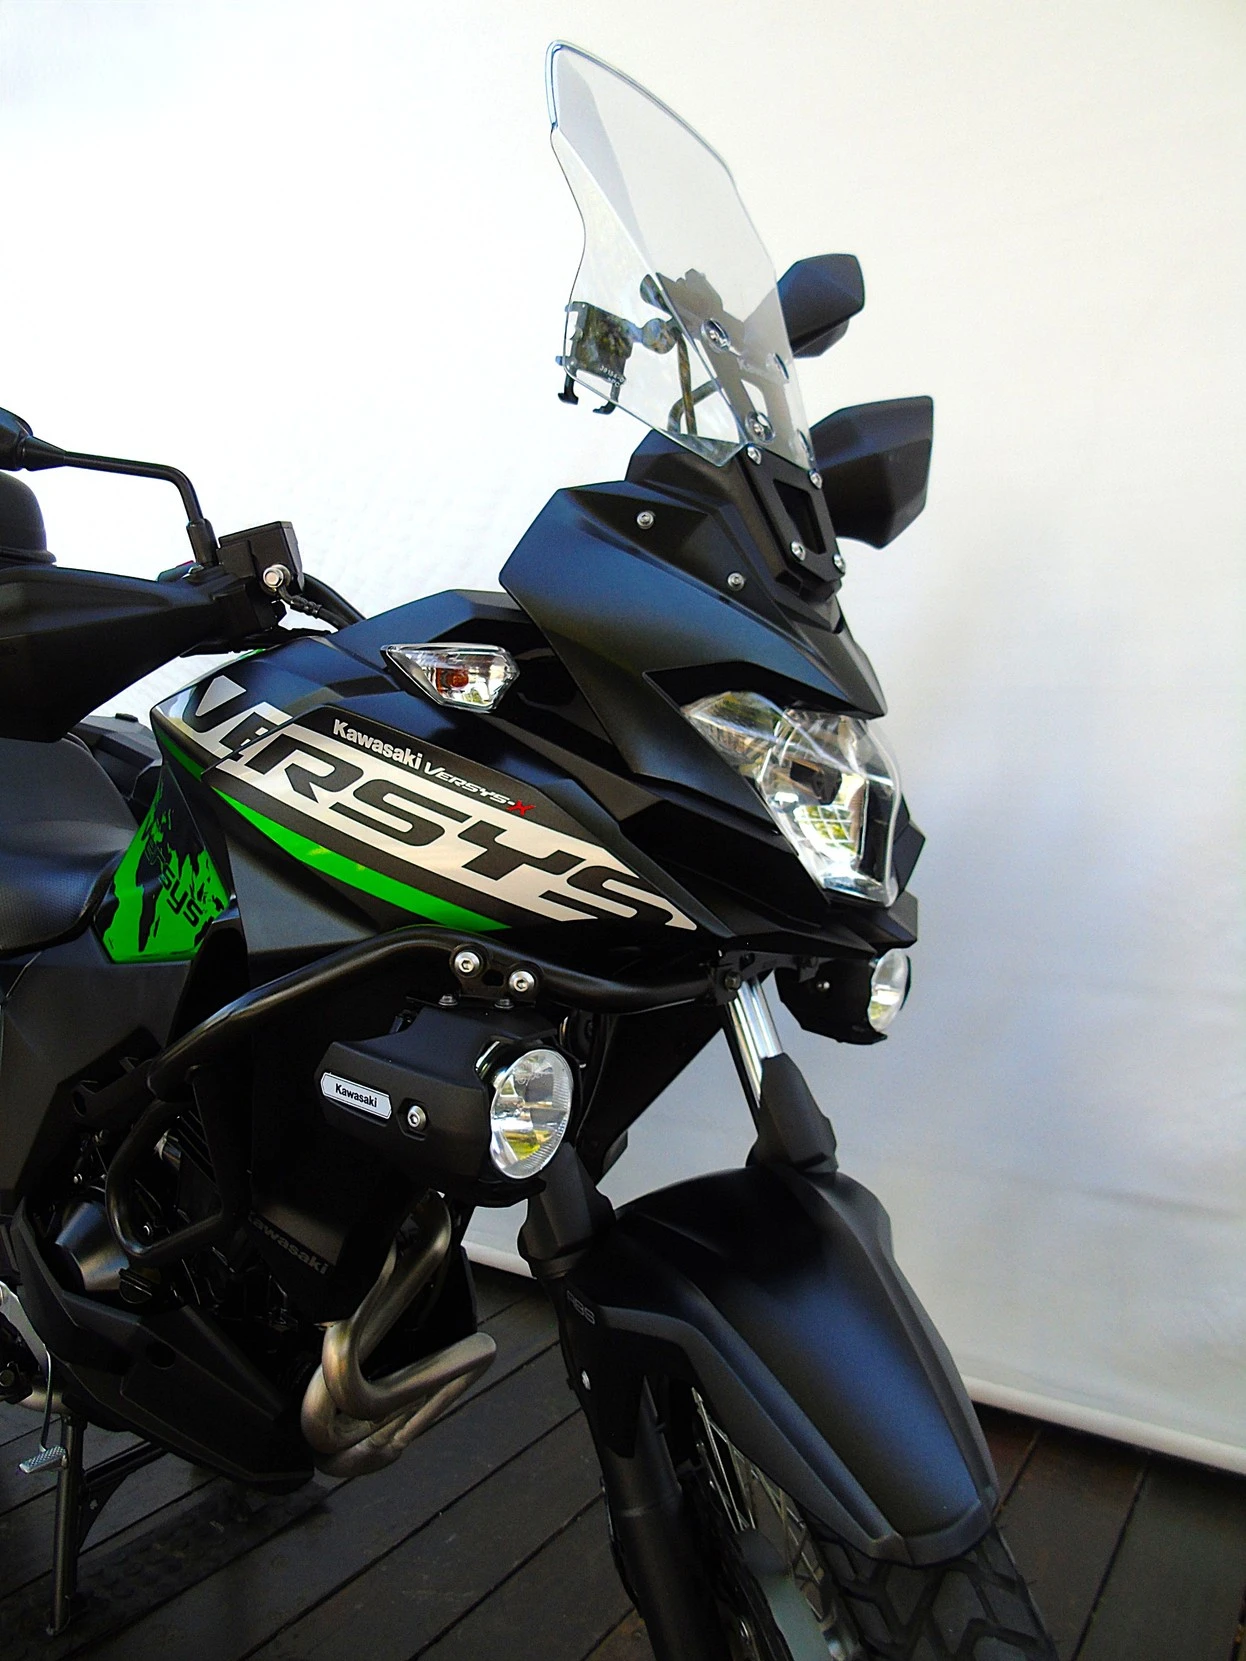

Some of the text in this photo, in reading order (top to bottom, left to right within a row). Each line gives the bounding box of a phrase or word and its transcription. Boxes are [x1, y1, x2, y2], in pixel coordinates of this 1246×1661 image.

[333, 718, 424, 771] Kawasaki
[182, 674, 694, 930] VERSYS
[335, 1082, 378, 1108] Kawasaki
